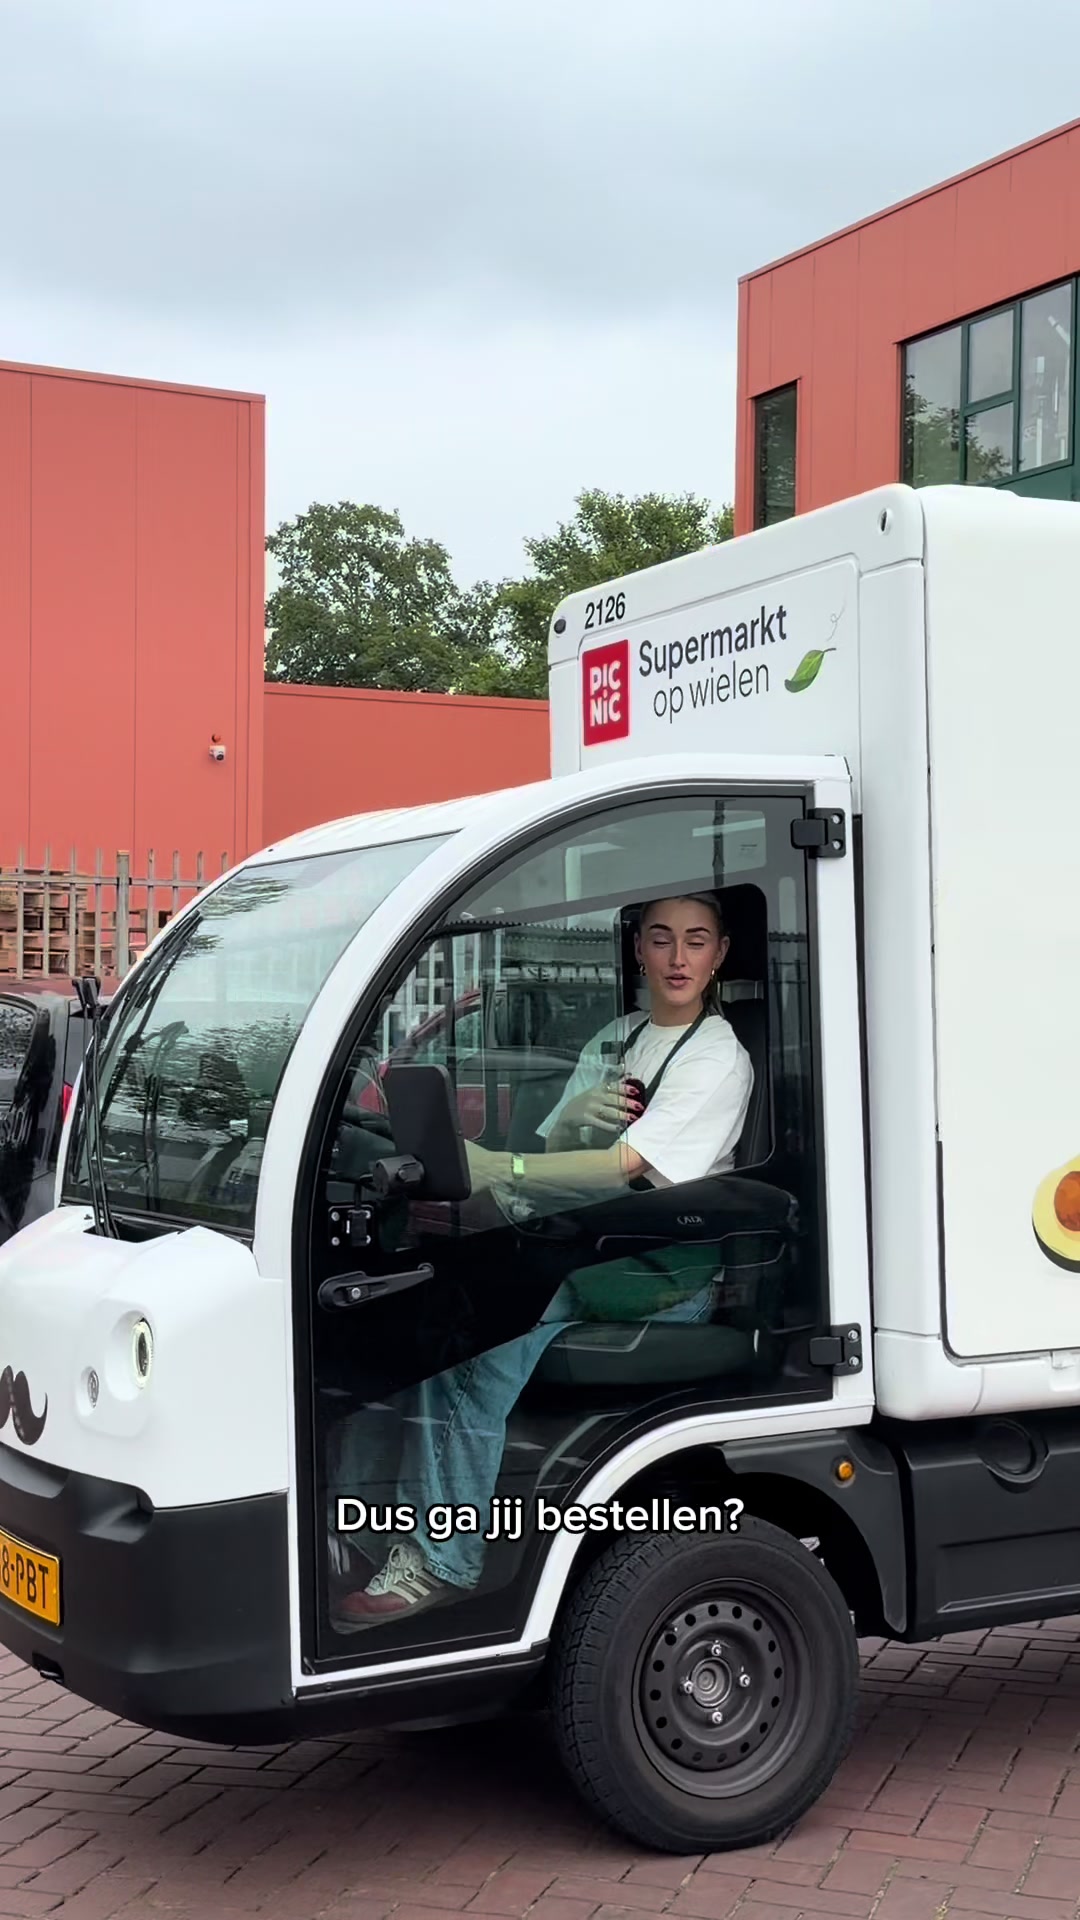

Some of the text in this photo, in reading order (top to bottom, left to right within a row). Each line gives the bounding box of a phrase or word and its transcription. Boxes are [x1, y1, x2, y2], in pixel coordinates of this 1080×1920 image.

[584, 593, 626, 629] 2126
[639, 605, 787, 679] Supermarkt
[653, 660, 769, 724] op wielen
